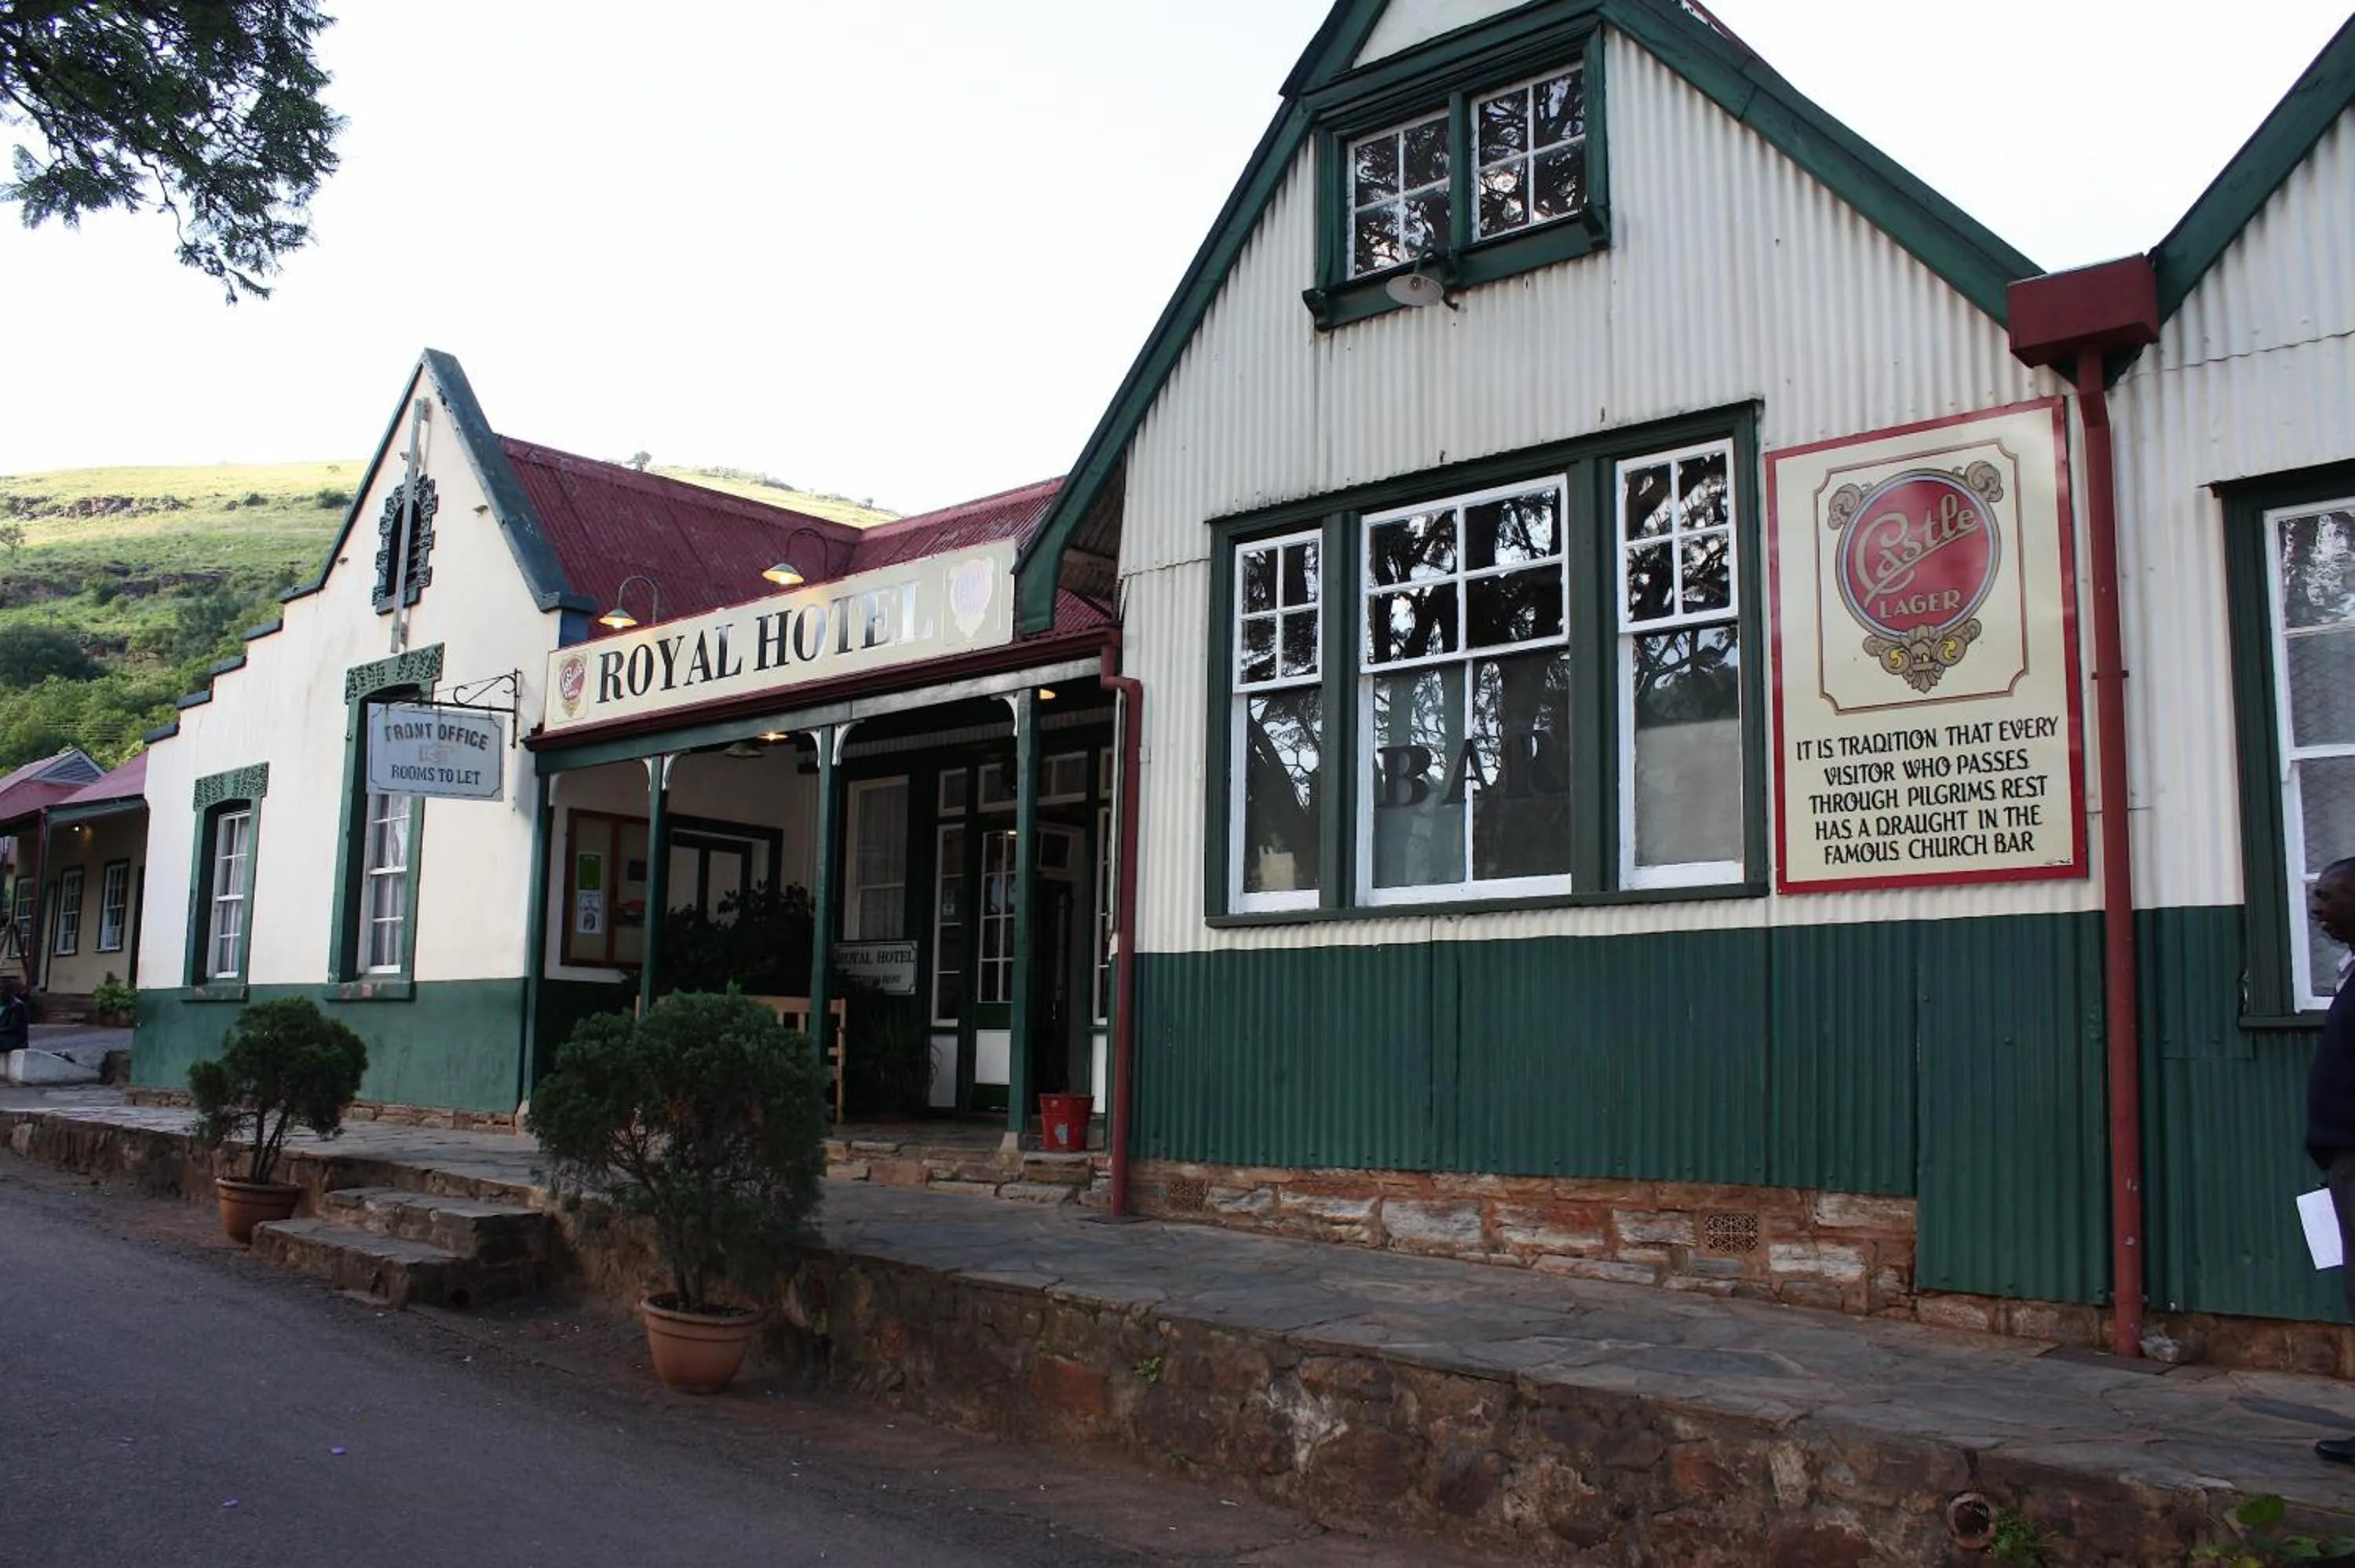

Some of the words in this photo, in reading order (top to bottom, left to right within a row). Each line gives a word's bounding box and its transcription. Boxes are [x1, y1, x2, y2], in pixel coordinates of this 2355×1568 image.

[1855, 494, 1980, 608] Castle
[1879, 589, 1962, 619] LAGER
[597, 623, 742, 704] ROYAL
[753, 579, 933, 672] HOTEL
[384, 723, 435, 742] FRONT
[437, 724, 490, 751] OFFICE
[1795, 740, 1814, 760] IT
[1817, 738, 1835, 759] IS
[1838, 727, 1938, 757] TRADITION
[1945, 722, 1994, 746] THAT
[1999, 716, 2060, 742] EVERY
[391, 764, 437, 782] ROOMS
[439, 768, 454, 782] TO
[457, 769, 481, 785] LET
[1375, 727, 1568, 808] BAR
[1823, 761, 1896, 786] VISITOR
[1902, 757, 1952, 779] WHO
[1956, 749, 2029, 775] PASSES
[1809, 789, 1899, 814] THROUGH
[1908, 782, 1996, 807] PILGRIMS
[2002, 775, 2048, 799] REST
[1815, 819, 1853, 840] HAS
[1857, 818, 1870, 837] A
[1875, 811, 1968, 836] DRAUGHT
[1978, 809, 1999, 829] IN
[2003, 804, 2043, 826] THE
[1824, 841, 1900, 865] FAMOUS
[1908, 834, 1988, 859] CHURCH
[1994, 830, 2035, 853] BAR
[877, 950, 916, 964] HOTEL
